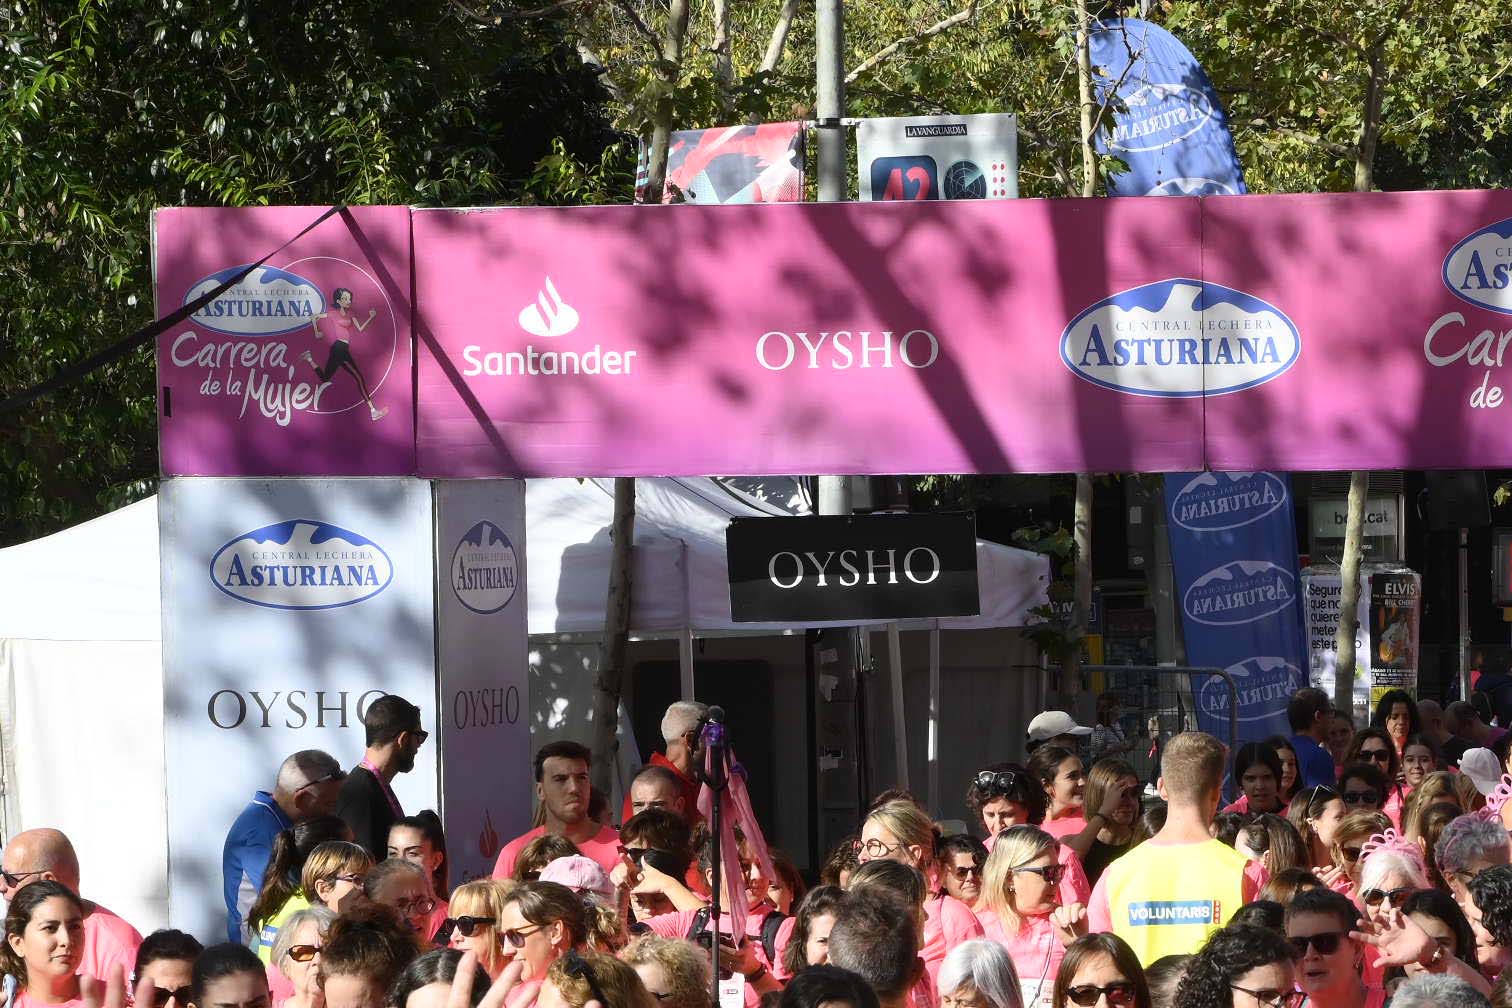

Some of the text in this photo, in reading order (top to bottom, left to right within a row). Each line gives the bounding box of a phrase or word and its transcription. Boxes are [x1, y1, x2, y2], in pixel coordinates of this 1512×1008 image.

[1115, 318, 1273, 331] CENTRAL LECHERA
[170, 331, 288, 368] Carrera
[462, 345, 638, 377] Santander
[756, 329, 939, 371] OYSHO
[1079, 323, 1281, 366] ASTURIANA
[200, 366, 333, 427] de la Mujer
[1469, 370, 1503, 408] de
[1335, 511, 1388, 524] b.cat
[224, 553, 380, 587] ASTURIANA
[252, 551, 373, 560] CENTRAL LECHERA
[768, 546, 941, 589] OYSHO
[456, 556, 514, 590] ASTURIANA
[1385, 582, 1415, 595] ELVIS
[1311, 612, 1343, 625] quiere
[454, 685, 520, 730] OYSHO
[1129, 905, 1210, 921] VOLUNTARIS
